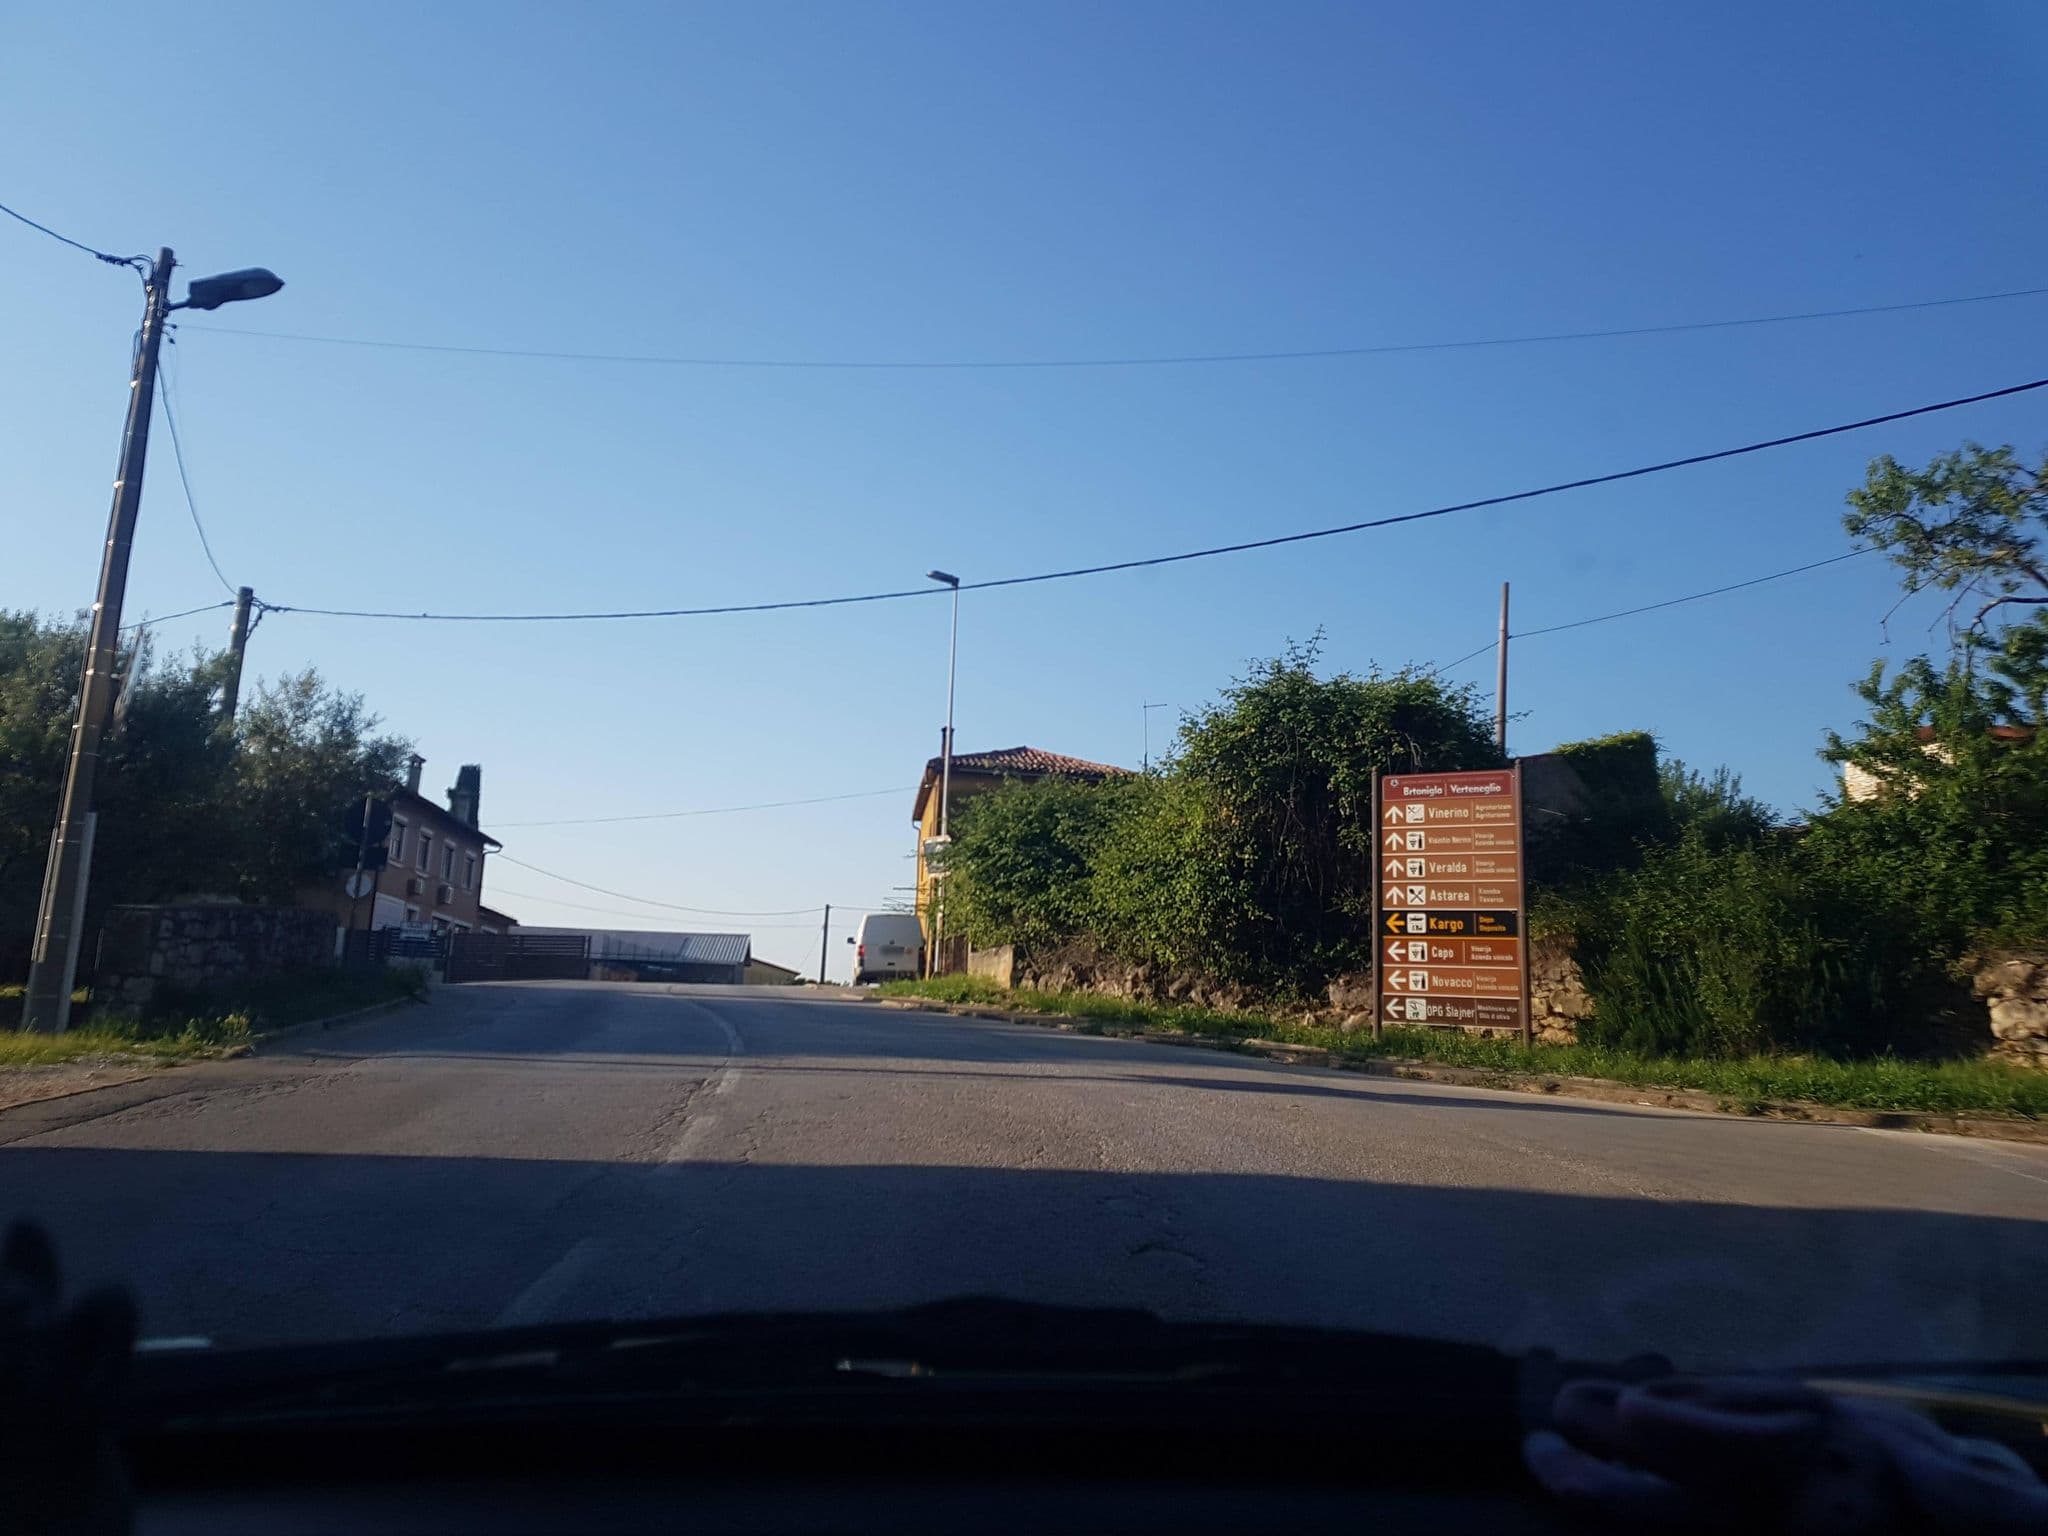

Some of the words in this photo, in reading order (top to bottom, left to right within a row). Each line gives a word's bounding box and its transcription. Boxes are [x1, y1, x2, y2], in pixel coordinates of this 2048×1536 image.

[1450, 783, 1501, 794] Verteneglio
[1428, 808, 1469, 818] Vinerino
[1429, 862, 1467, 873] Veralda
[1430, 889, 1470, 901] Astarea
[1429, 917, 1464, 932] Kargo
[1432, 946, 1454, 959] Capo
[1432, 975, 1473, 988] Novacco
[1427, 1007, 1443, 1017] OPG
